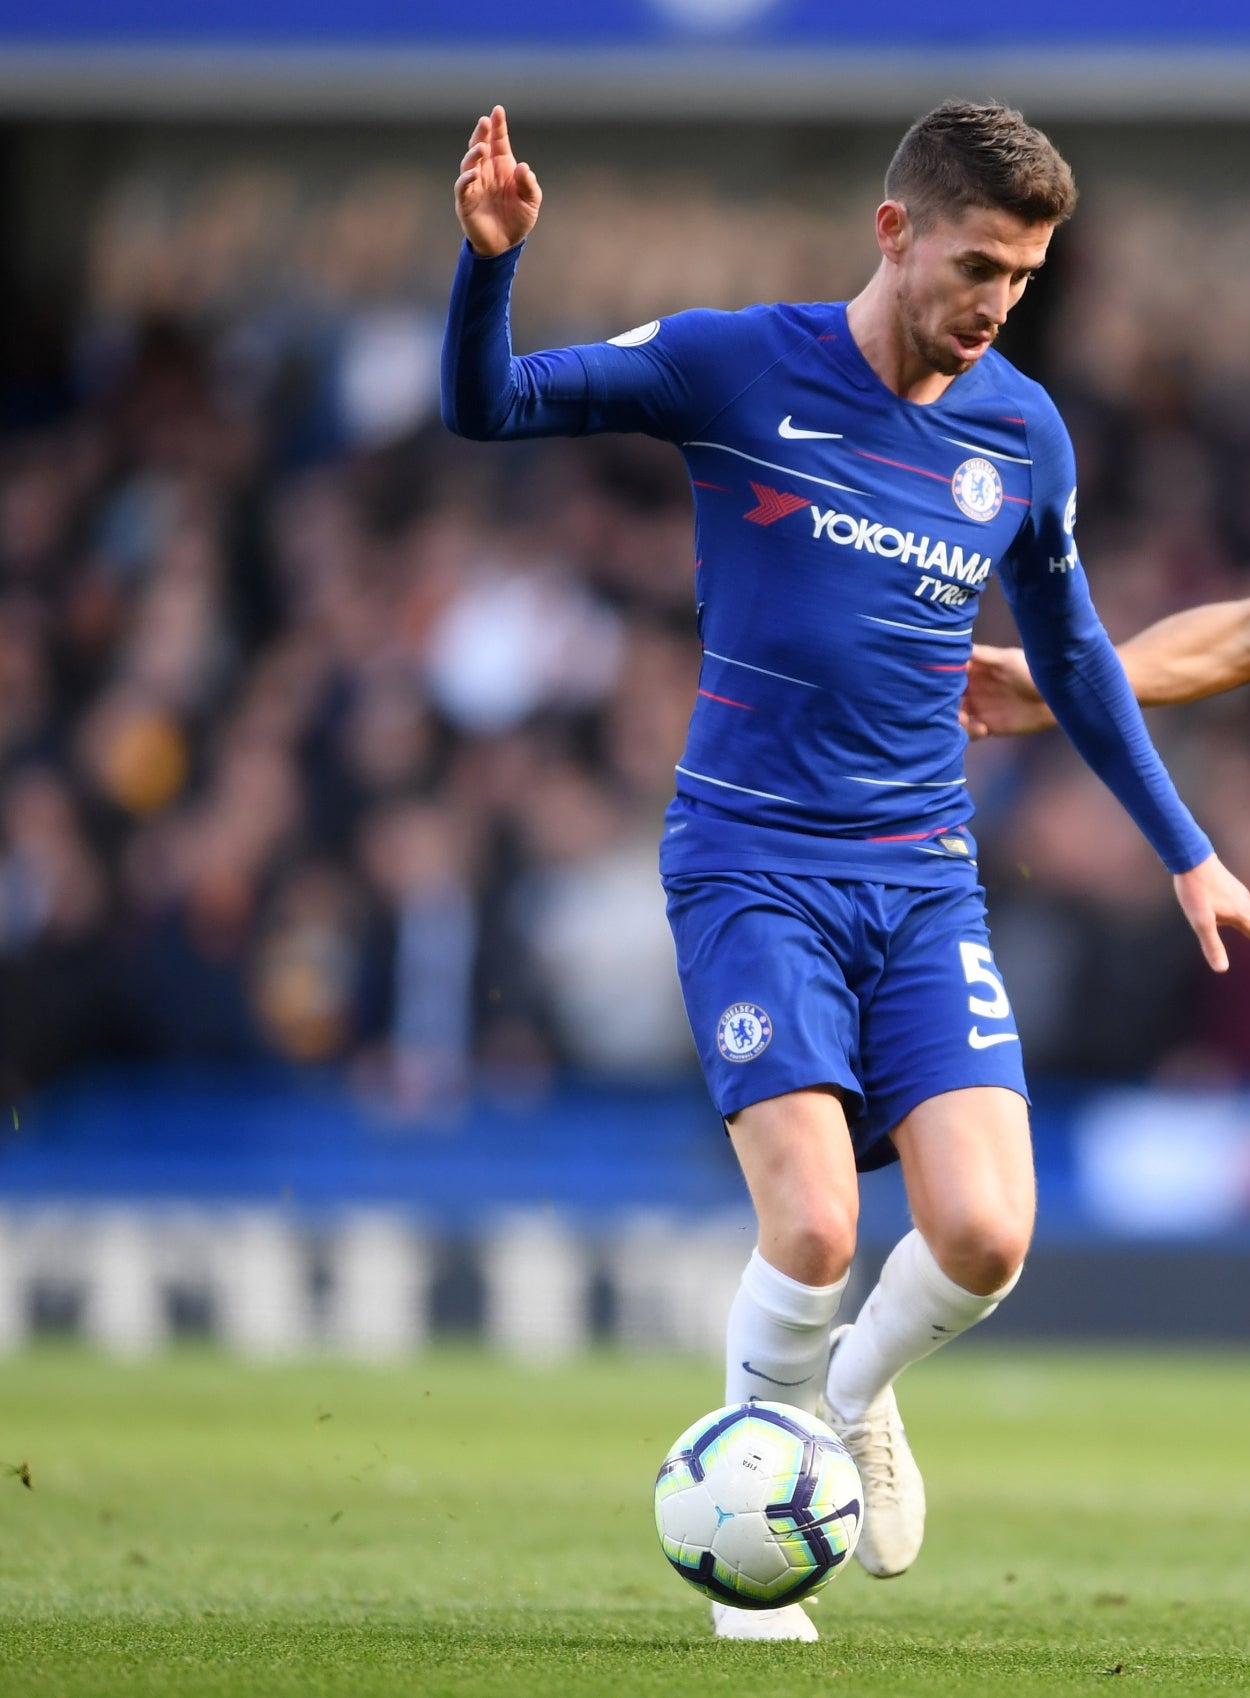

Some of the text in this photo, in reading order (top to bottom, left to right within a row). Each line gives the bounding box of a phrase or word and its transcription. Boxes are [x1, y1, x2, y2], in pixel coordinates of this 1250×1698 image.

[810, 505, 992, 585] YOKOHAMA
[721, 1005, 755, 1026] CHELSEA
[959, 942, 1010, 1019] 5
